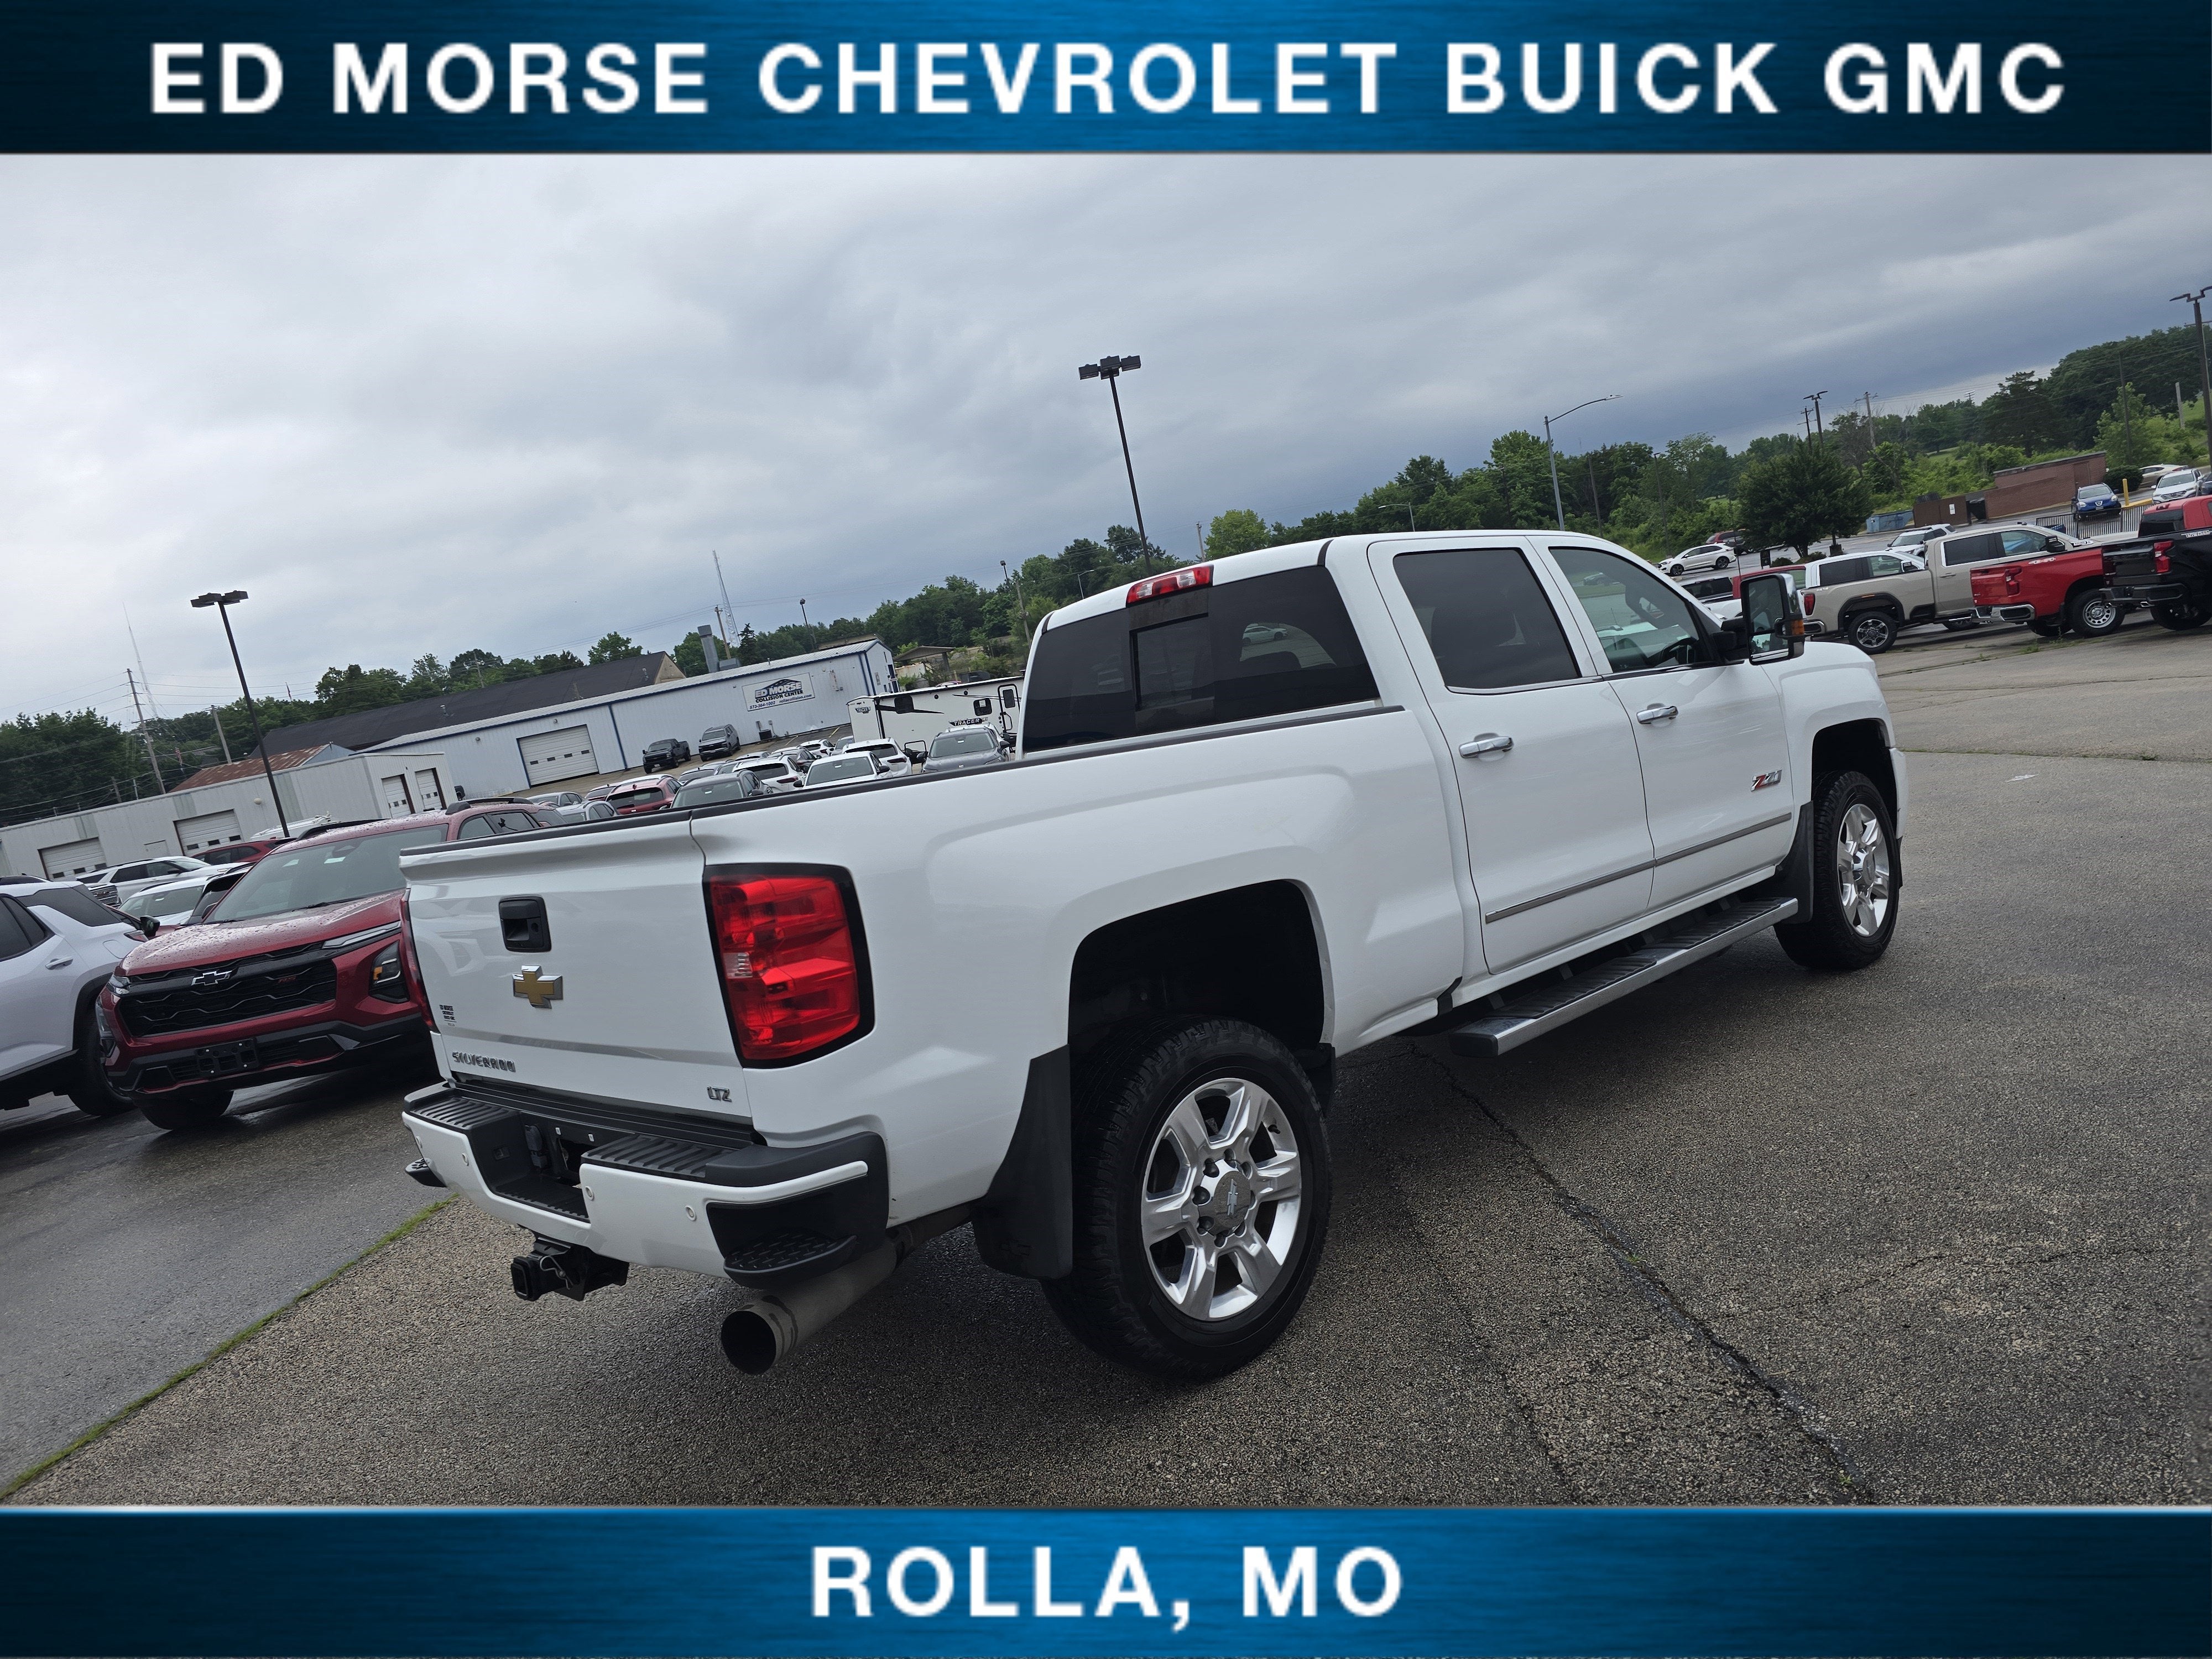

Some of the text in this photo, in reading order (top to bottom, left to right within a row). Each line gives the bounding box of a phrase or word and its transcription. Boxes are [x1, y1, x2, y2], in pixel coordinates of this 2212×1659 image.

[769, 682, 802, 695] MORSE
[755, 694, 784, 703] COLLISION
[452, 1051, 516, 1073] SILVERADO
[707, 1086, 732, 1102] LTZ
